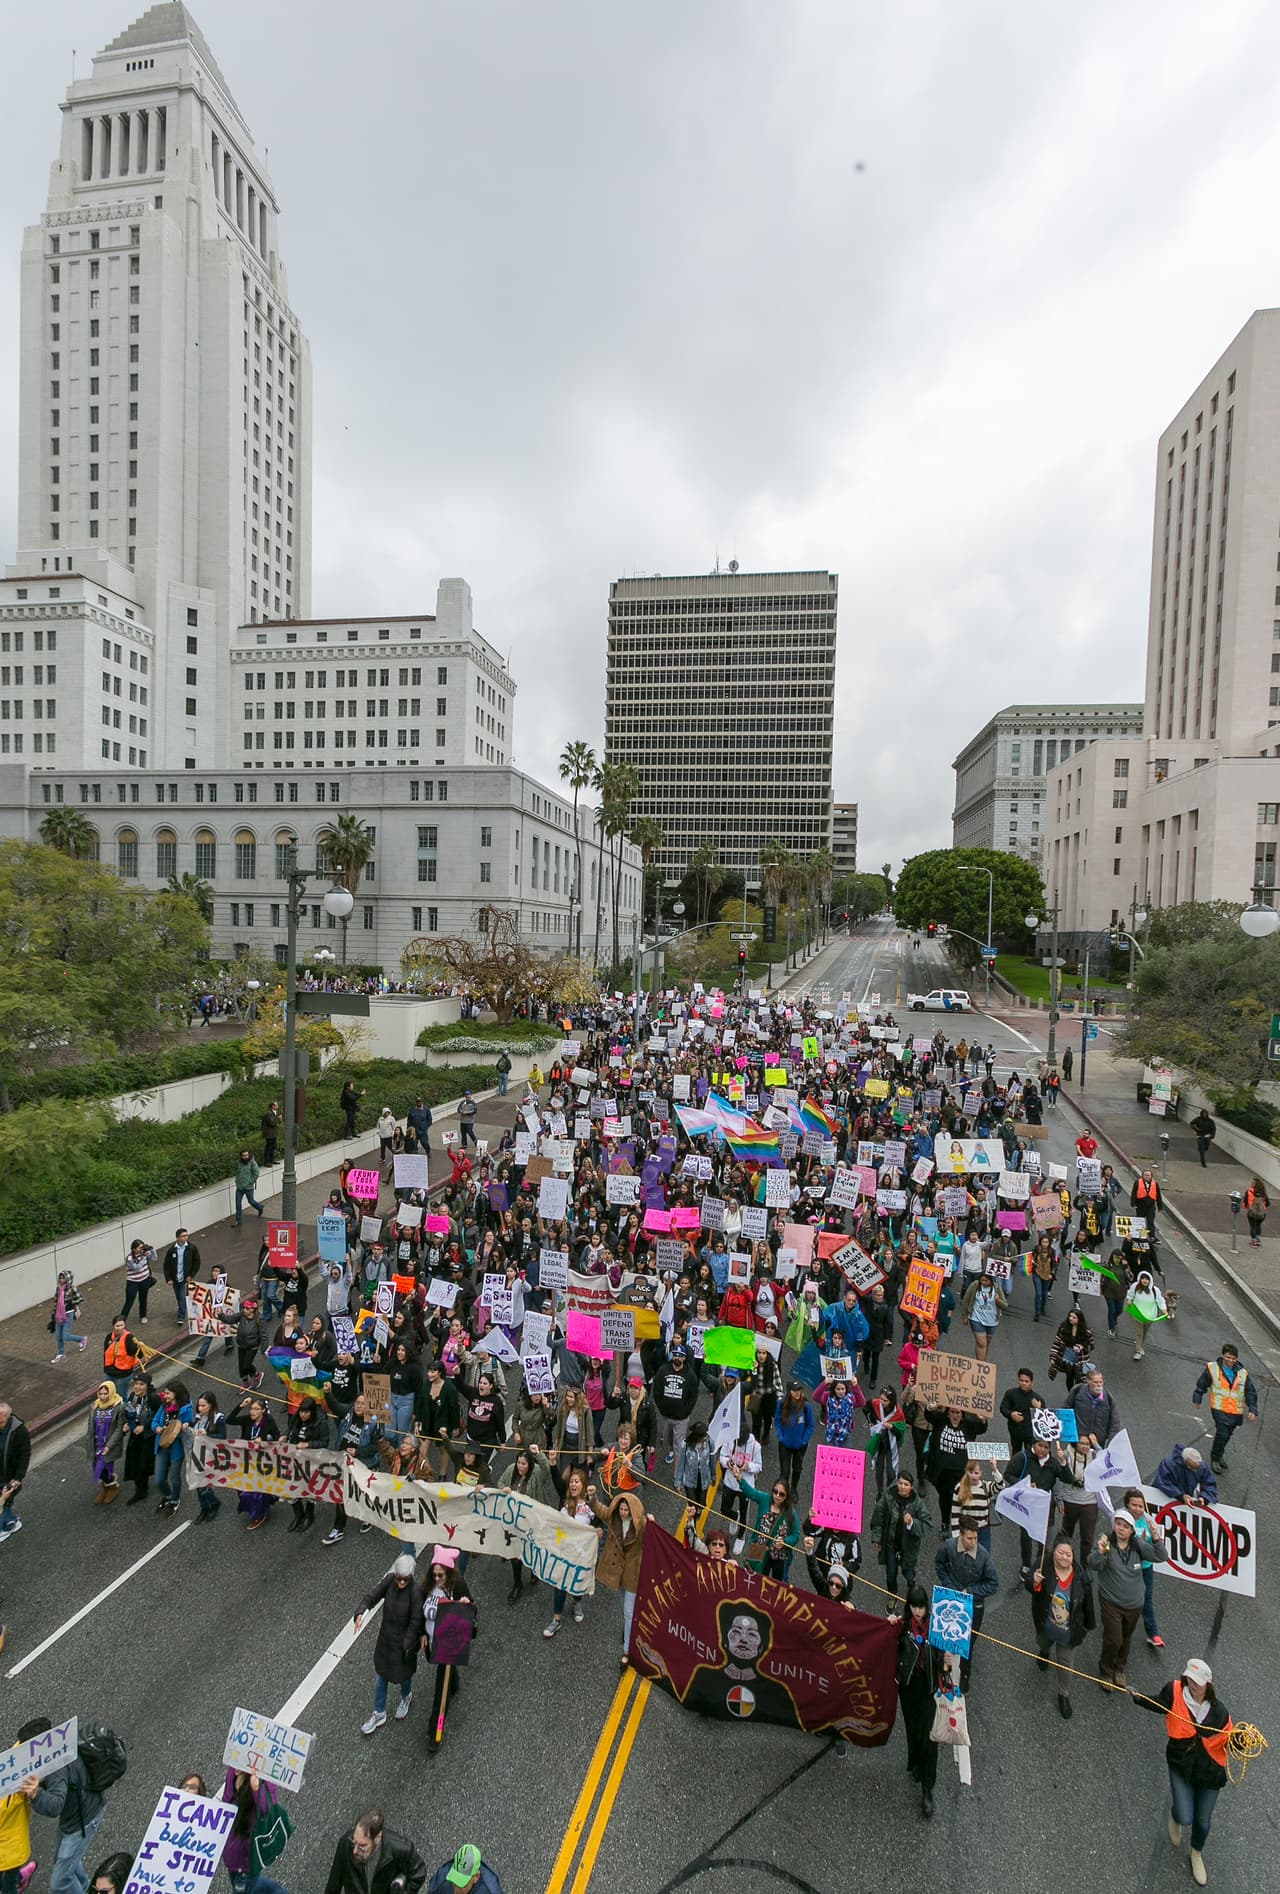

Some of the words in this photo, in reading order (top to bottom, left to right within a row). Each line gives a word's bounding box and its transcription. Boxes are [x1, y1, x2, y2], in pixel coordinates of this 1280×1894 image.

[842, 1250, 852, 1259] AM
[540, 1270, 566, 1279] ABORTION
[186, 1280, 236, 1306] PEAE
[602, 1320, 633, 1328] DEFEND
[603, 1311, 623, 1319] UNITE
[605, 1330, 631, 1338] TRANS
[605, 1337, 630, 1346] LIVES!
[921, 1351, 942, 1364] THEY
[976, 1363, 991, 1375] TO
[930, 1365, 966, 1384] BURY
[971, 1375, 987, 1390] US
[919, 1382, 940, 1392] THEY
[976, 1391, 993, 1400] KNOW
[923, 1393, 939, 1404] WE
[946, 1395, 970, 1409] WERE
[971, 1397, 993, 1413] SEEDS
[968, 1441, 1010, 1452] STRONGER
[968, 1450, 1010, 1460] TOGETHER
[190, 1445, 345, 1504] NDIGENOUS
[347, 1472, 439, 1525] WOMEN
[467, 1490, 532, 1531] RISE
[520, 1537, 592, 1595] UNITE
[695, 1557, 738, 1593] AND
[668, 1618, 717, 1662] WOMEN
[769, 1660, 831, 1694] UNITE
[29, 1721, 72, 1757] MY
[229, 1728, 257, 1749] NOT
[270, 1744, 285, 1763] BE
[236, 1708, 255, 1730] WE
[264, 1725, 305, 1758] WILL
[1, 1743, 70, 1787] resident
[156, 1791, 181, 1819] I
[177, 1800, 236, 1835] CANT
[158, 1821, 217, 1859] believe
[139, 1842, 160, 1861] I
[166, 1850, 216, 1879] STILL
[133, 1864, 167, 1888] have
[172, 1878, 196, 1894] to
